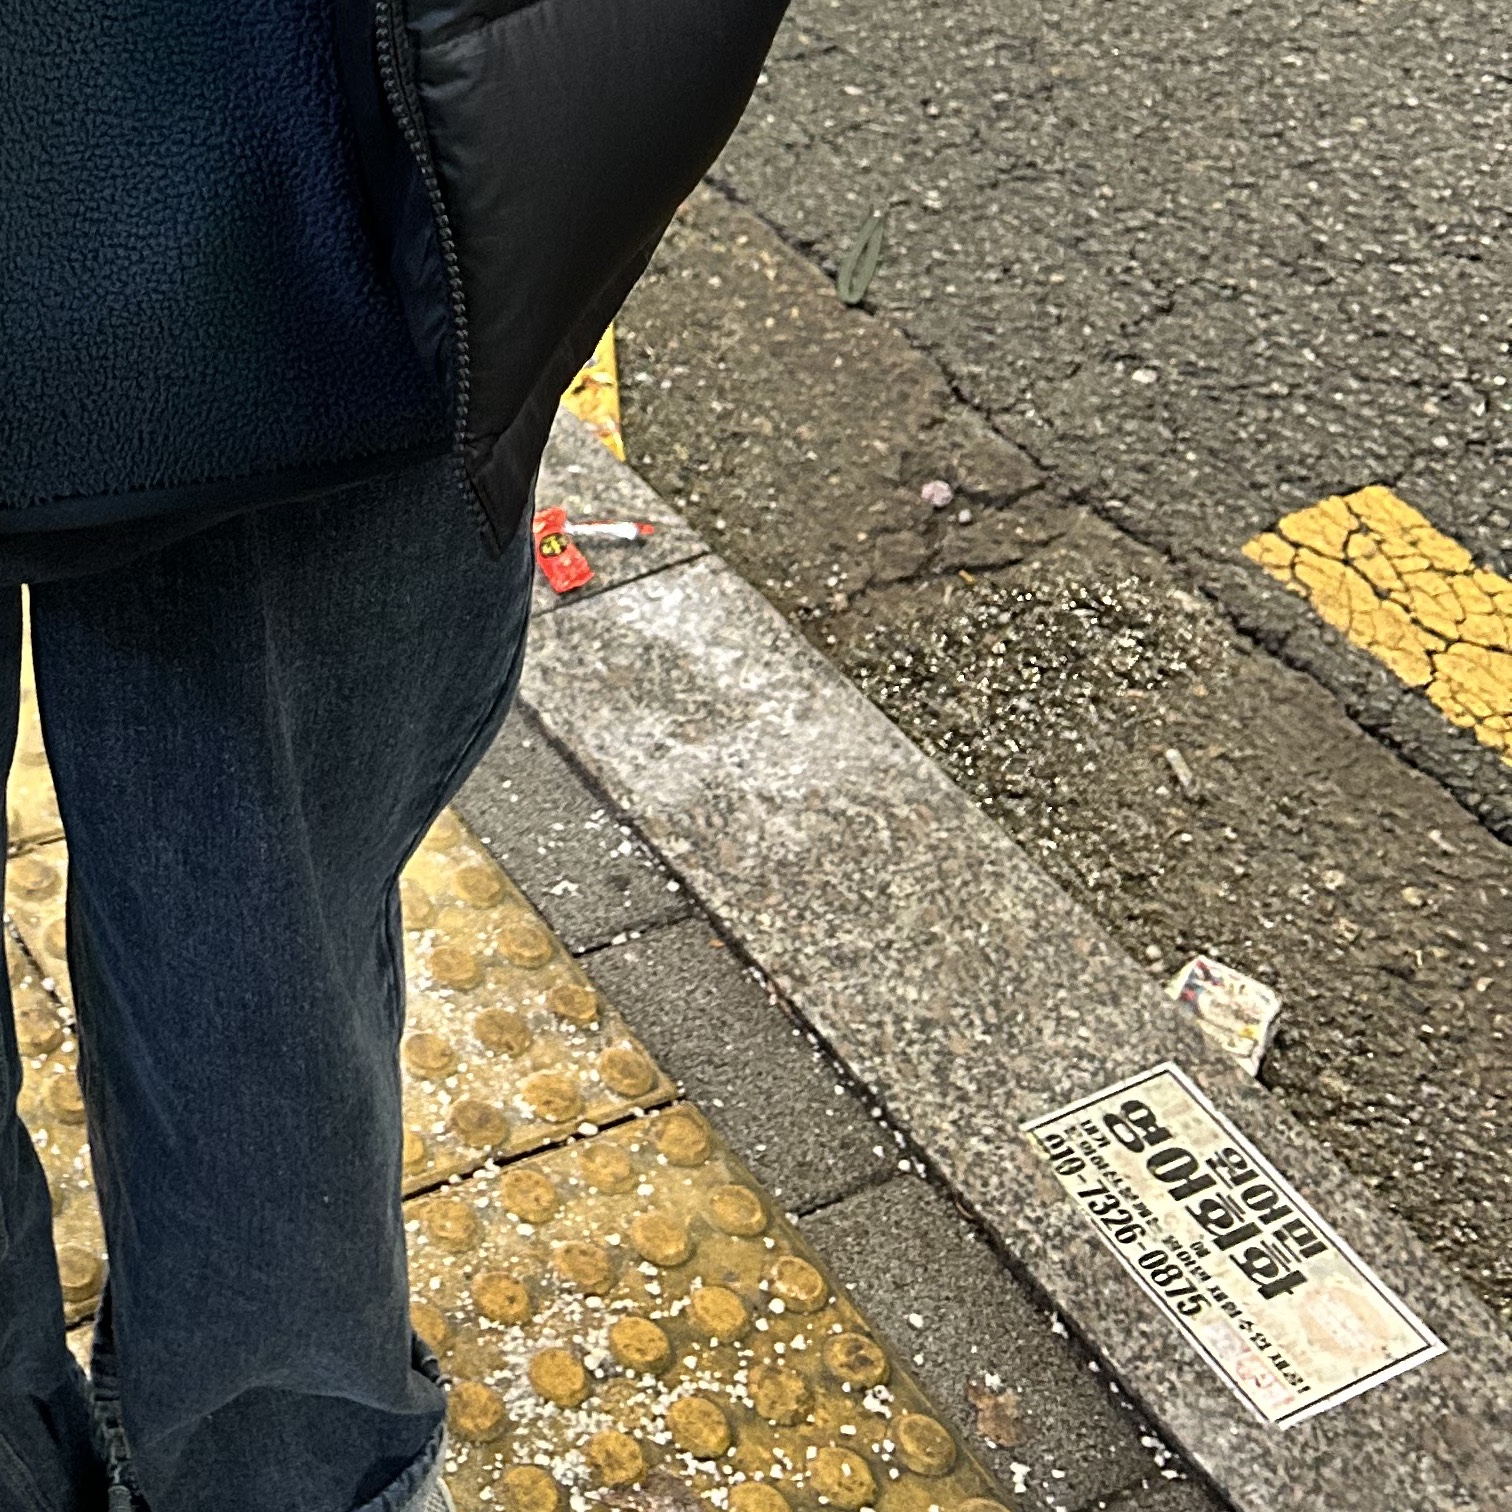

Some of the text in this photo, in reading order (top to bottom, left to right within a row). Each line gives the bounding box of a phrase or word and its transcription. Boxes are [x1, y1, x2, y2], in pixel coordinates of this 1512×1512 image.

[1044, 1134, 1211, 1316] 010-7326-0875
[1103, 1100, 1307, 1300] 영어회화
[1206, 1148, 1327, 1262] 원어민
